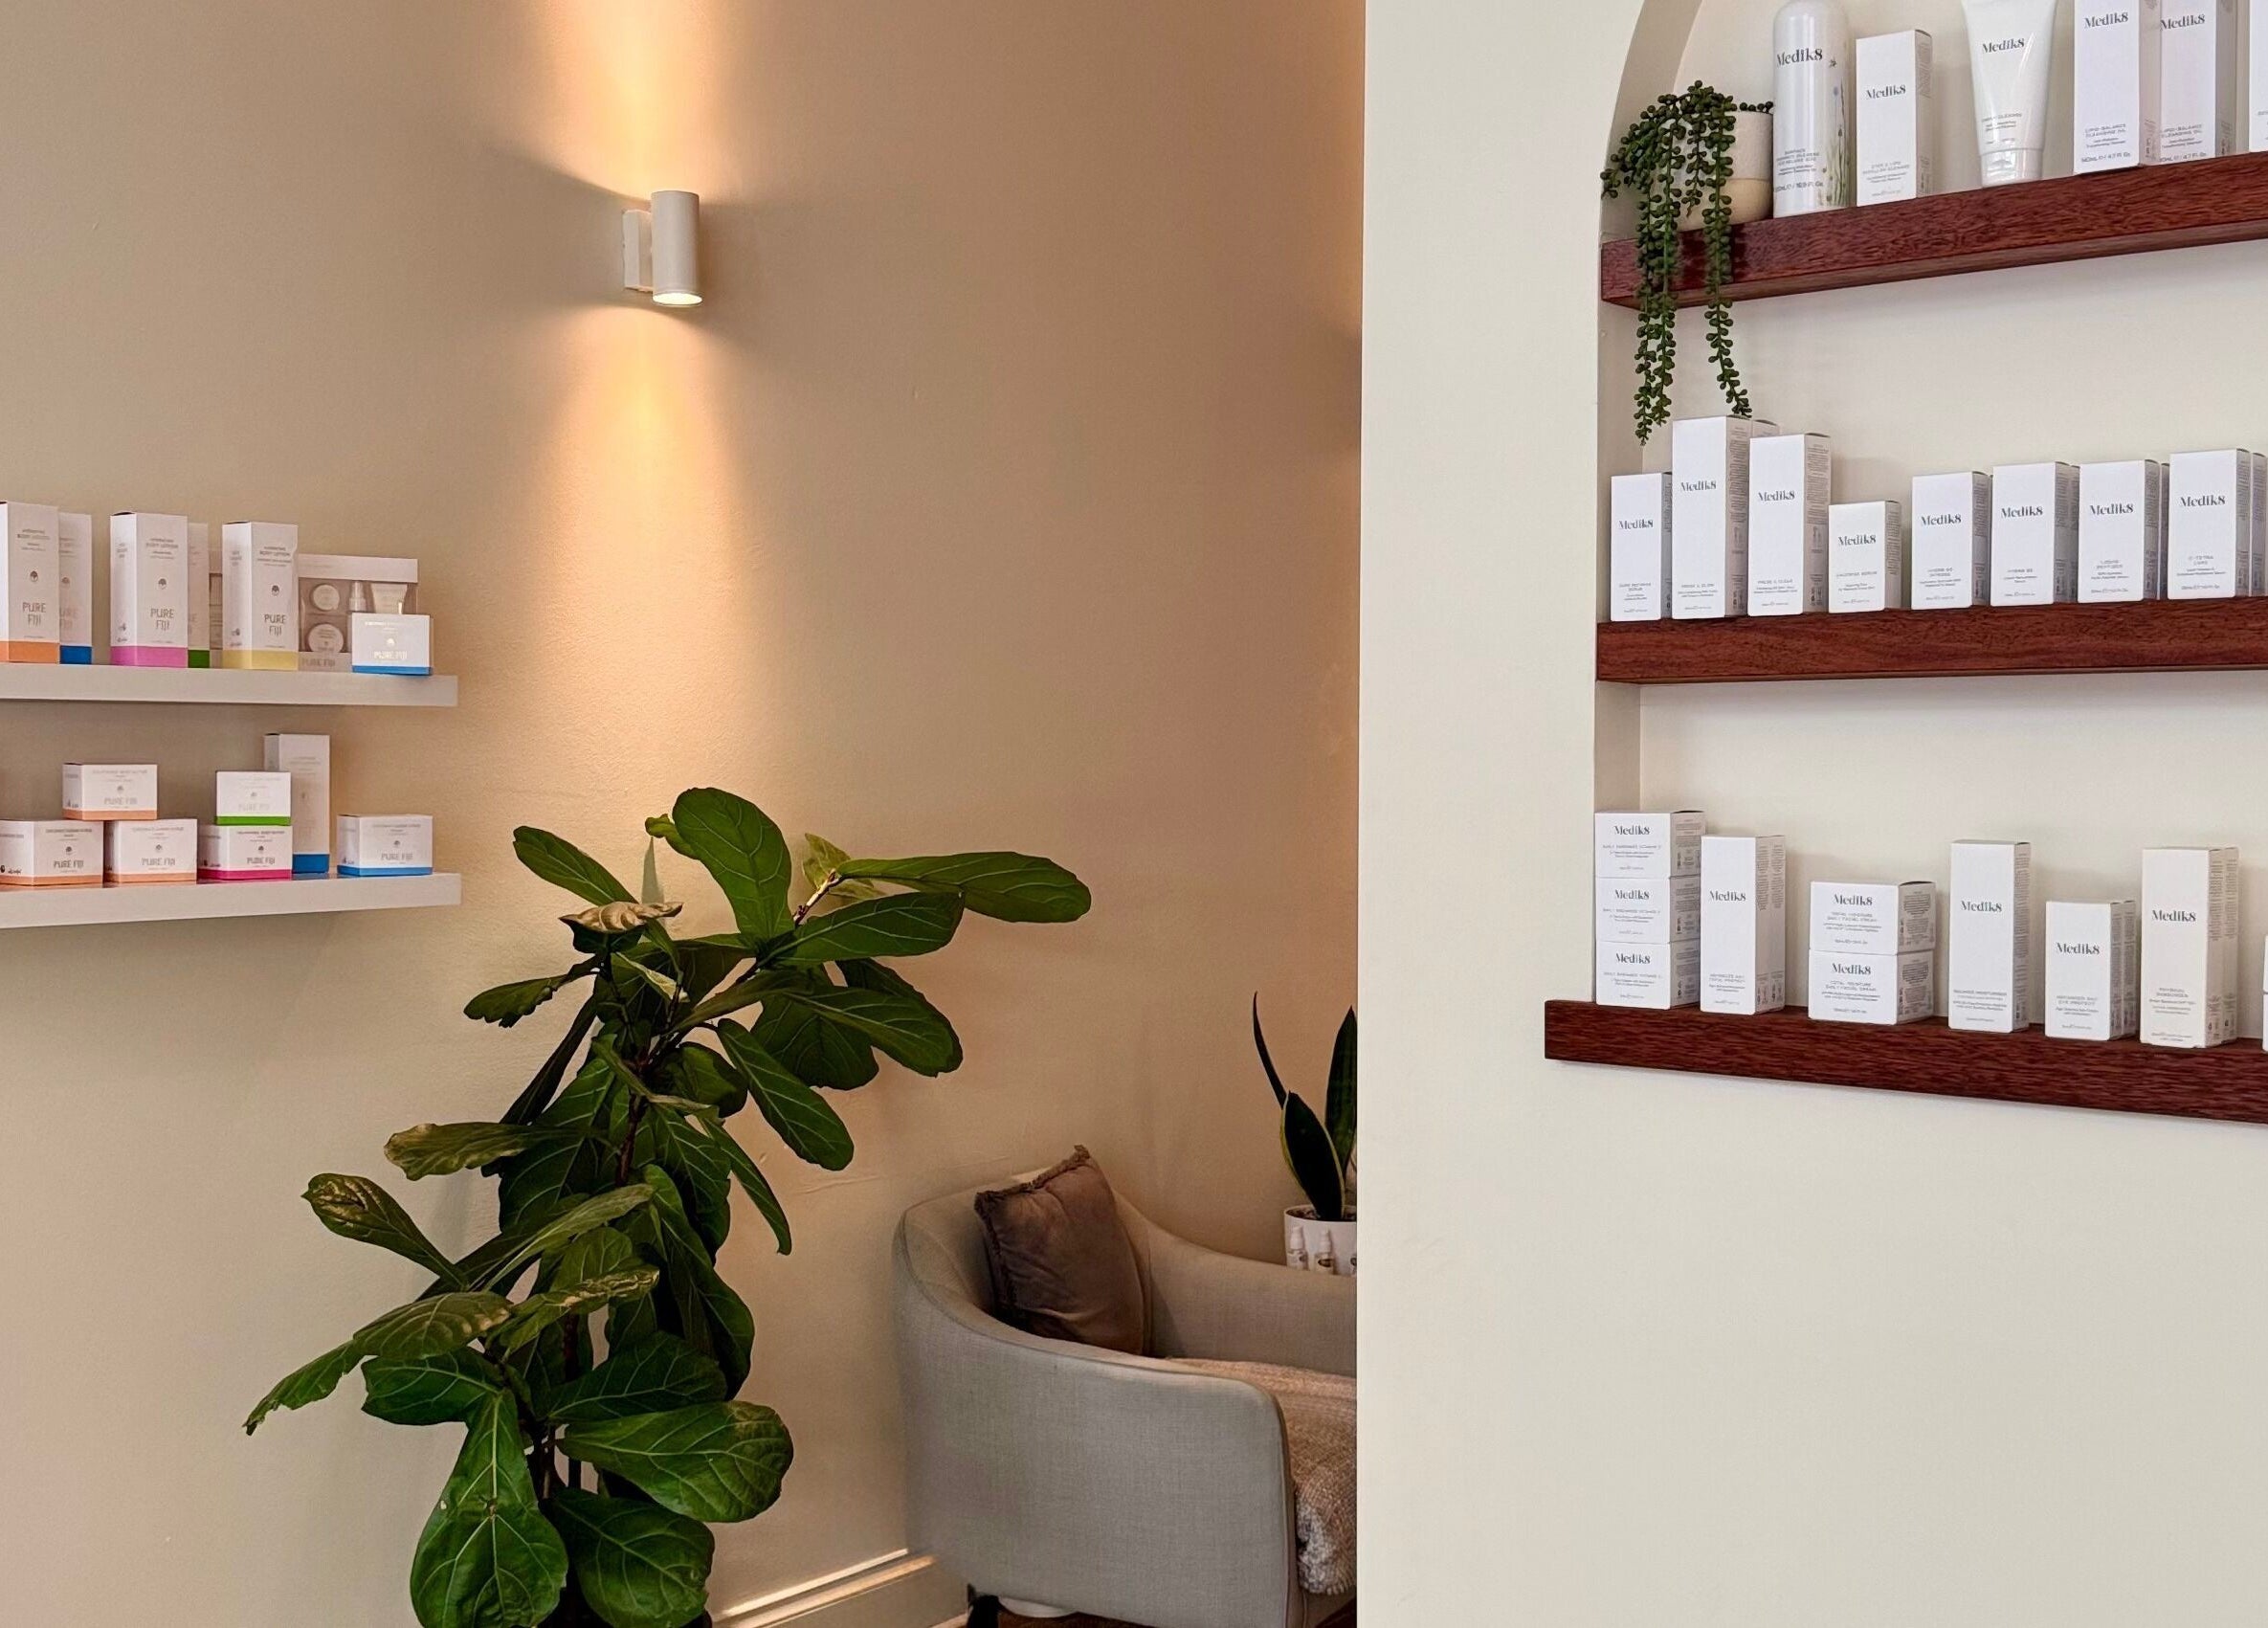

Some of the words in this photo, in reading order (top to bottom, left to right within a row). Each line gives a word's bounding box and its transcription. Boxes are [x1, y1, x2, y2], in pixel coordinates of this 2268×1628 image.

[2084, 11, 2128, 29] Medik8
[2160, 13, 2205, 30] Medik8
[1983, 37, 2025, 54] Medik8
[1777, 48, 1823, 67] Medik8
[1866, 84, 1906, 100] Medik8
[1680, 480, 1717, 492] Medik8
[1758, 490, 1795, 502] Medik8
[2180, 494, 2226, 507] Medik8
[2000, 505, 2043, 519] Medik8
[2090, 503, 2134, 515] Medik8
[1618, 519, 1654, 530] Medik8
[1922, 513, 1962, 526] Medik8
[1837, 534, 1877, 546] Medik8
[22, 602, 46, 613] PURE
[59, 608, 78, 617] URE
[150, 608, 174, 619] PURE
[28, 615, 41, 628] FIJI
[264, 613, 286, 624] PURE
[156, 619, 169, 632] FIJI
[269, 625, 282, 636] FIJI
[1613, 825, 1650, 836] Medik8
[141, 858, 161, 867] PURE
[1614, 889, 1650, 900] Medik8
[1709, 890, 1746, 902] Medik8
[1834, 894, 1873, 906] Medik8
[1961, 900, 2002, 913] Medik8
[2151, 909, 2196, 923] Medik8
[2056, 942, 2100, 955] Medik8
[1615, 953, 1651, 964] Medik8
[1832, 963, 1872, 974] Medik8
